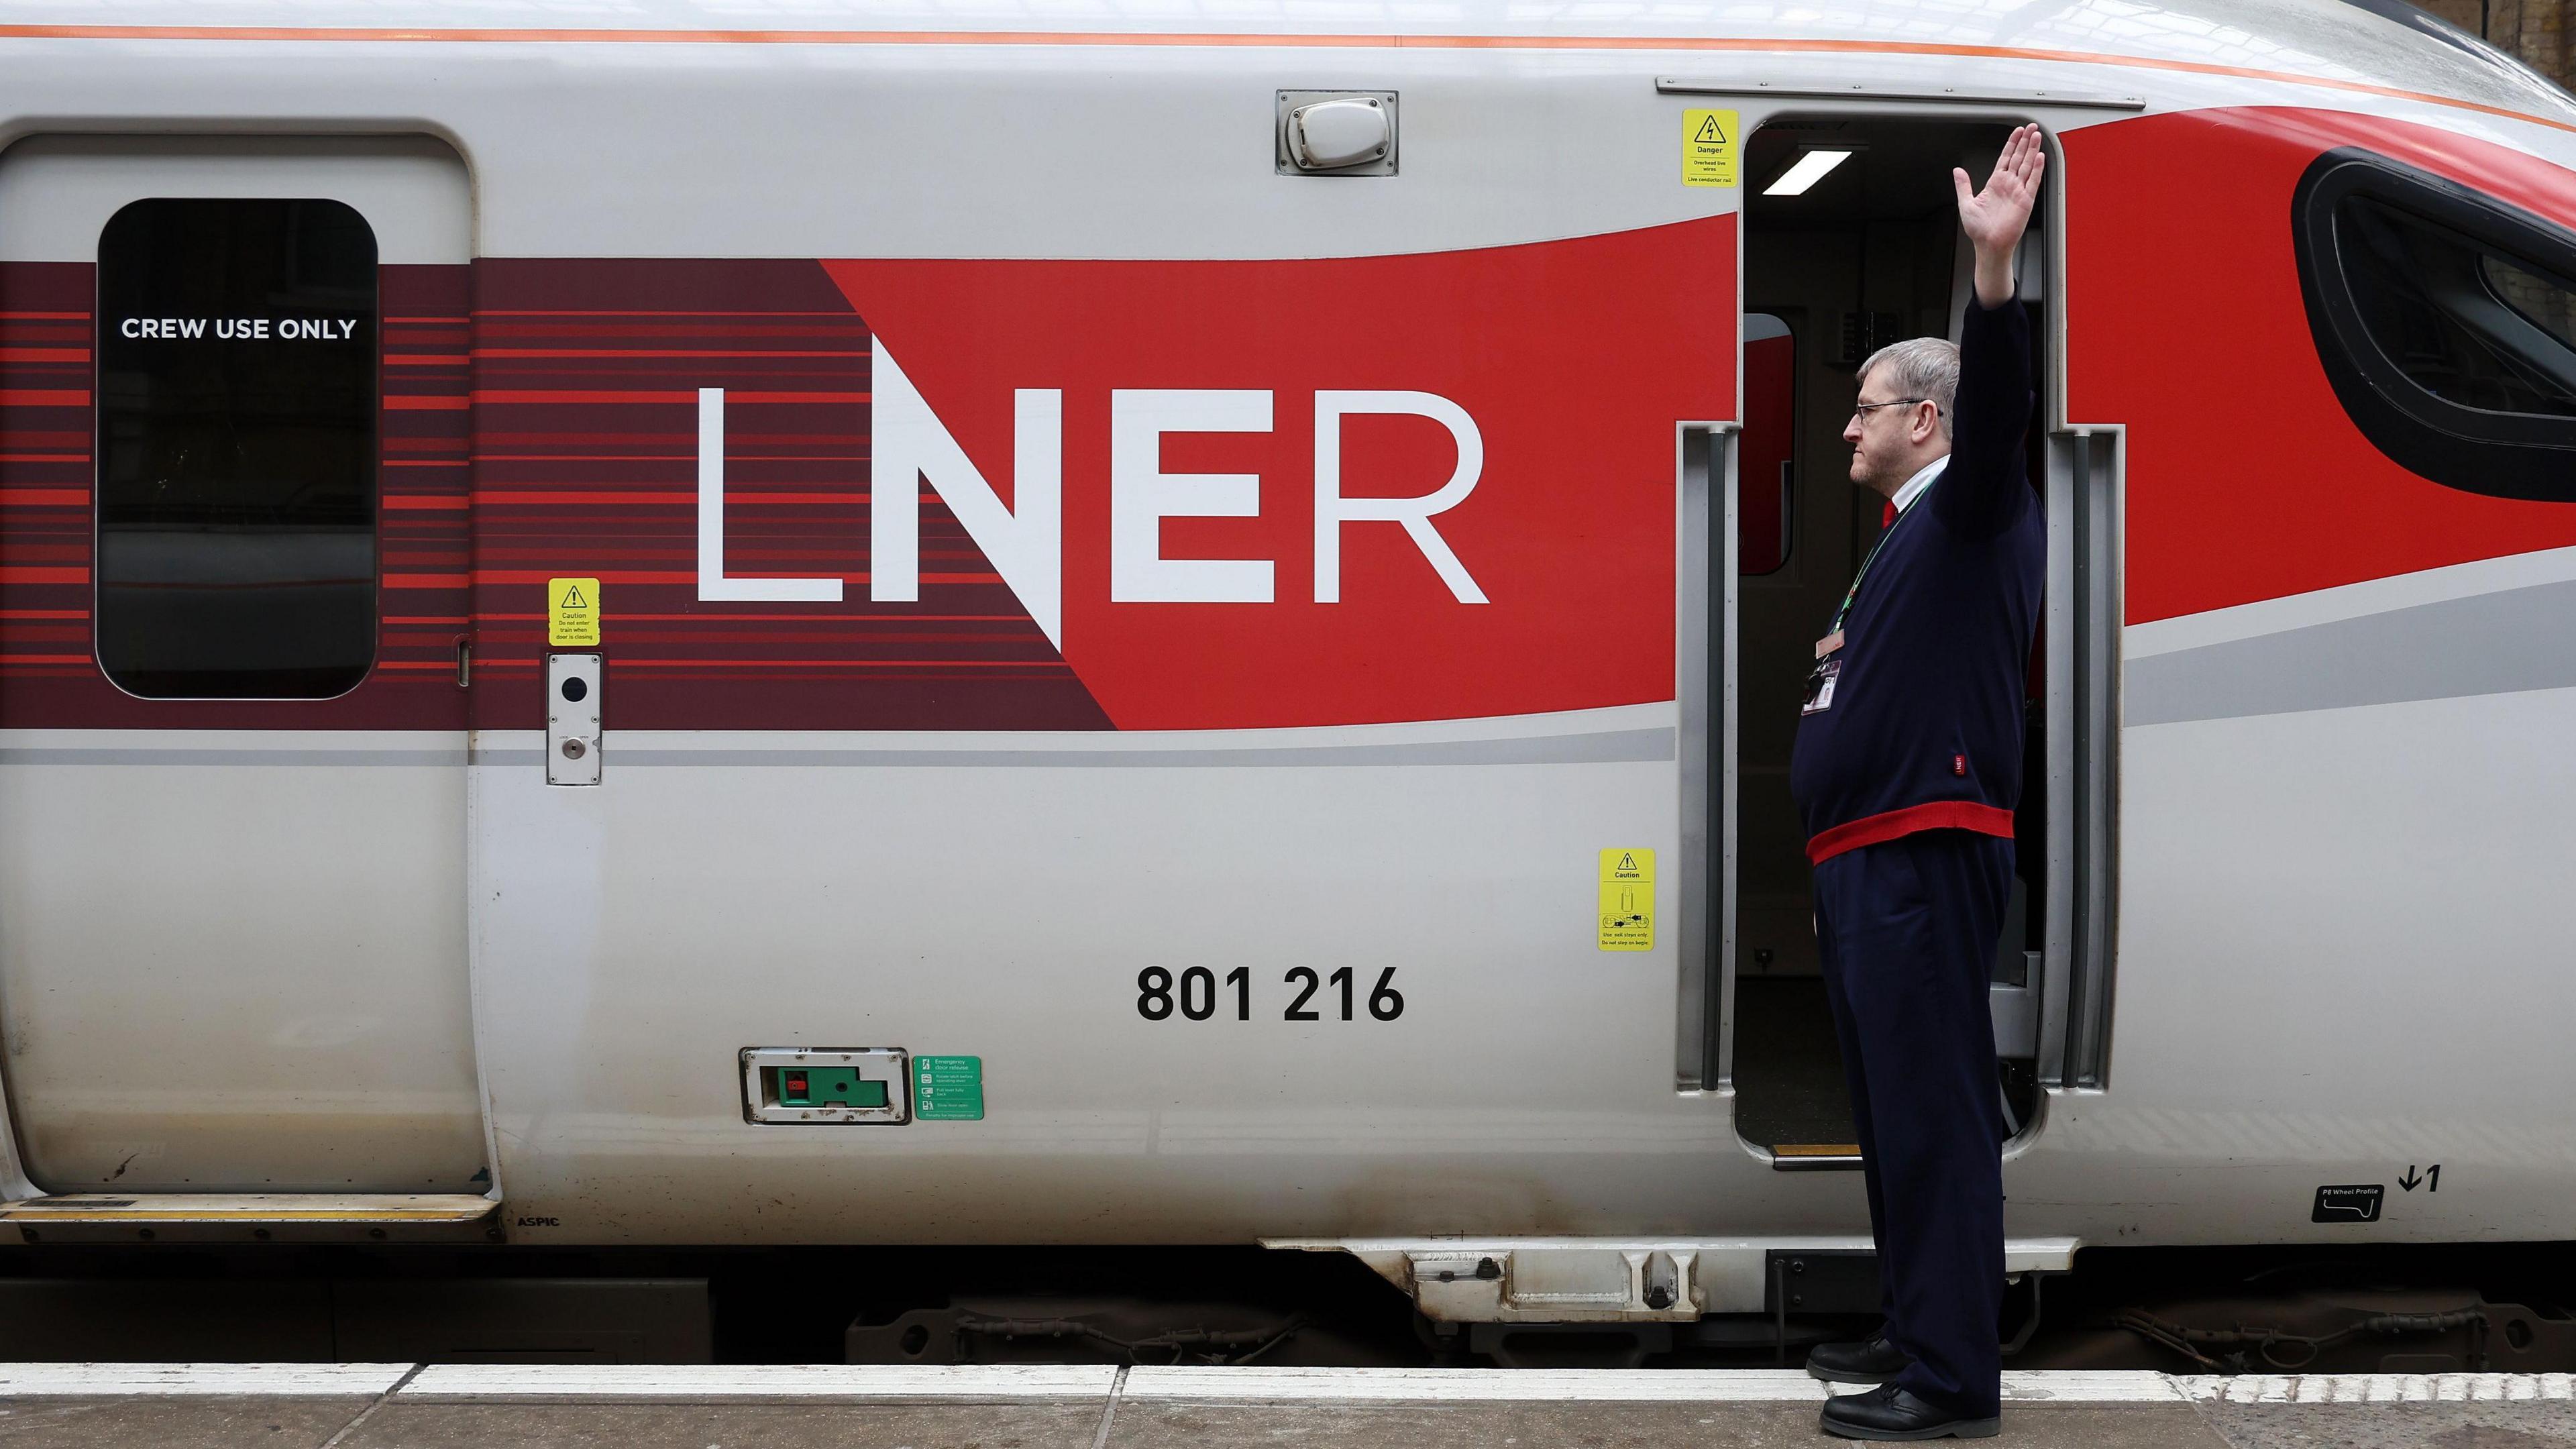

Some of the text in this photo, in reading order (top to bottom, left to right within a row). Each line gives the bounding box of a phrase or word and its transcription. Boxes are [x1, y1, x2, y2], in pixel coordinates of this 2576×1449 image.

[1697, 146, 1723, 154] Danger
[122, 319, 356, 339] CREW USE ONLY
[698, 333, 1490, 653] LNER
[1138, 966, 1404, 1021] 801 216
[2426, 1164, 2440, 1192] 1
[517, 1217, 560, 1226] ASPIC
